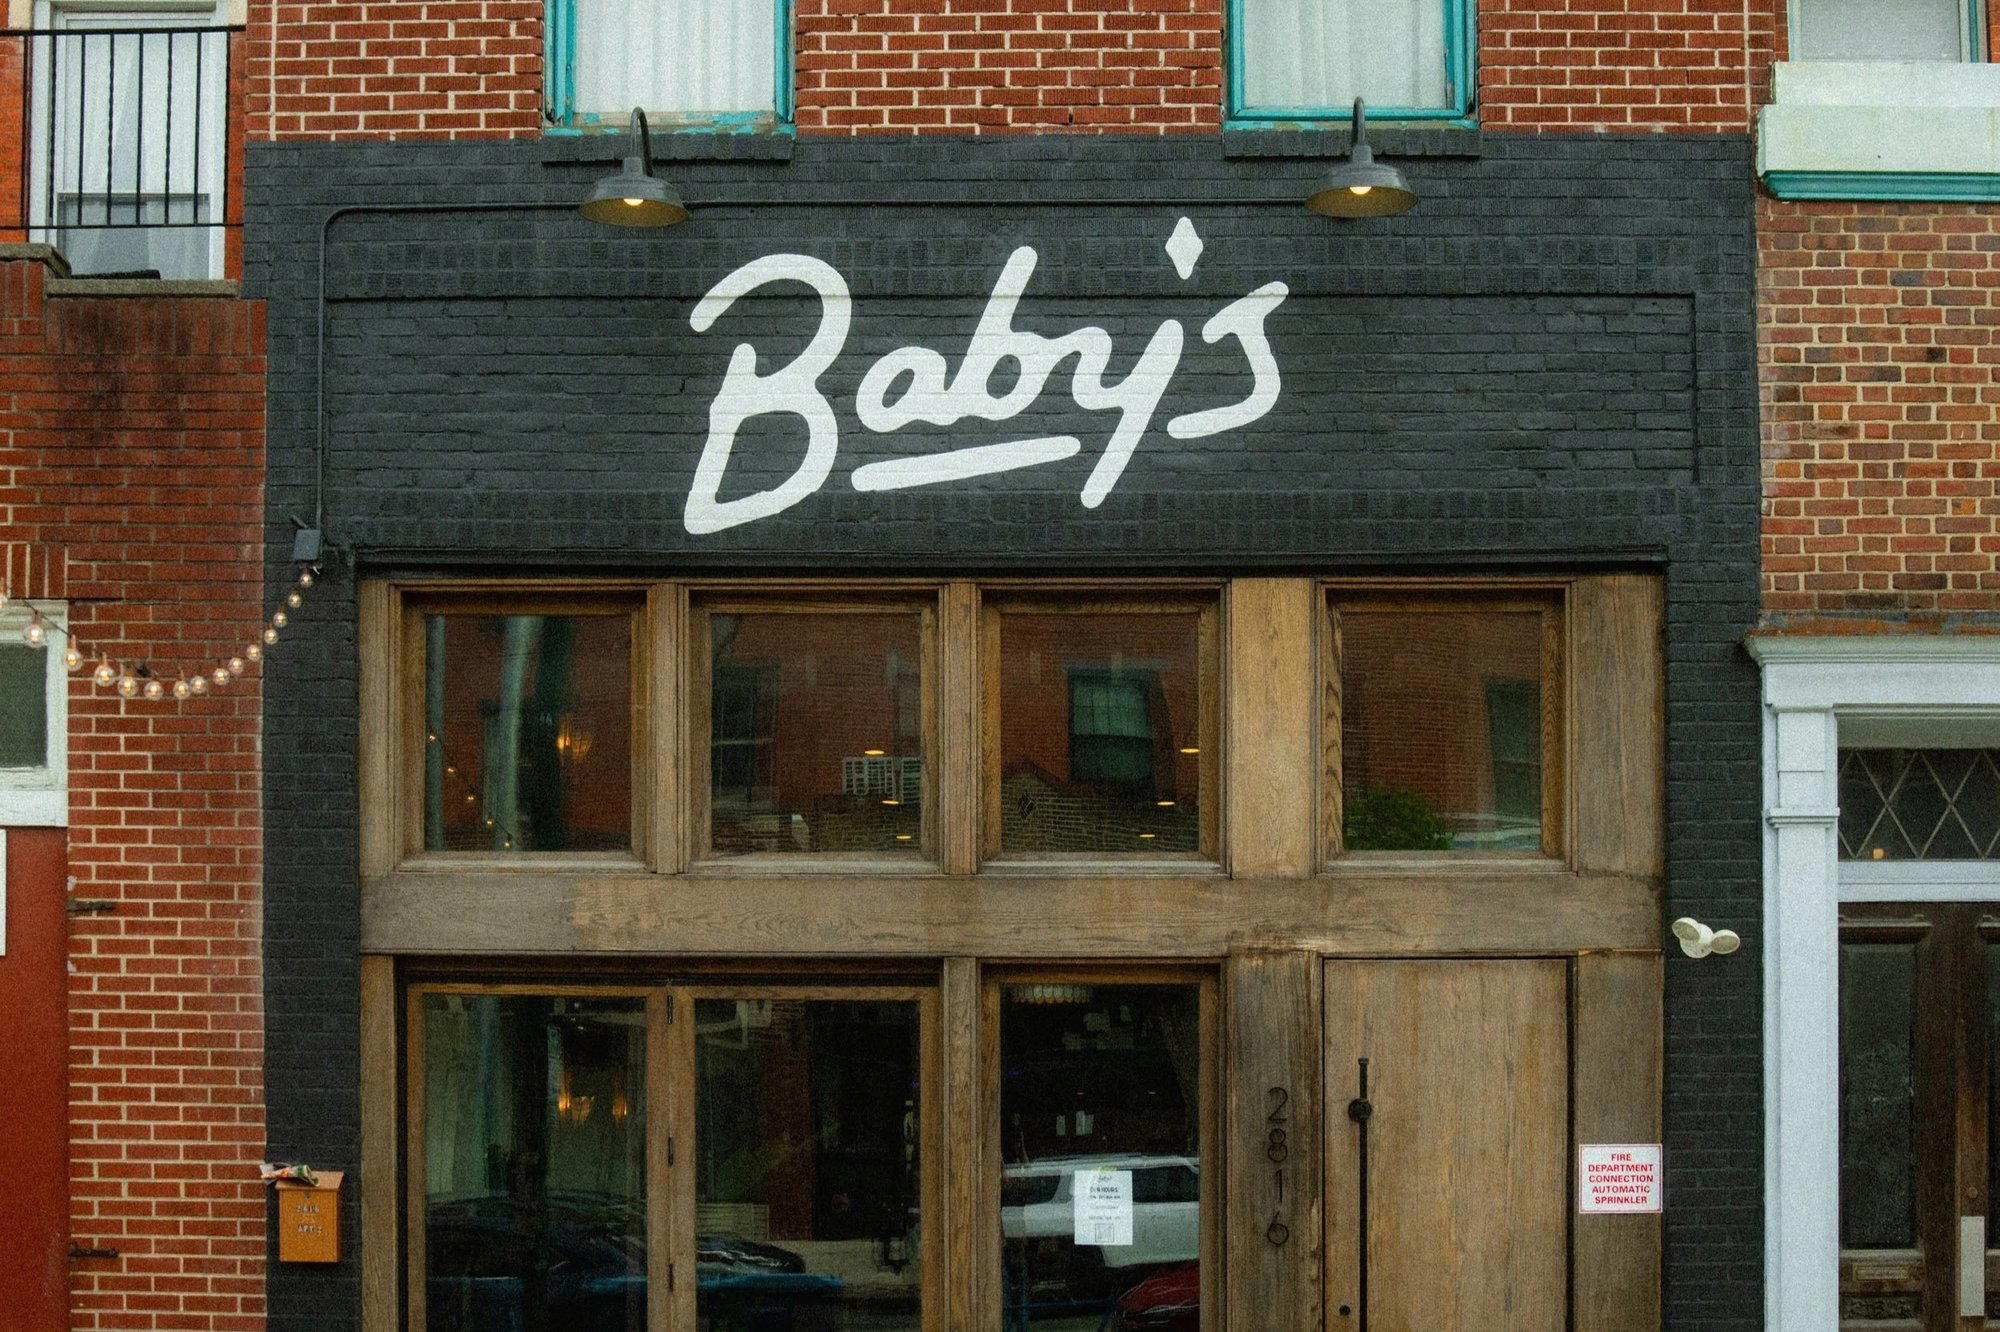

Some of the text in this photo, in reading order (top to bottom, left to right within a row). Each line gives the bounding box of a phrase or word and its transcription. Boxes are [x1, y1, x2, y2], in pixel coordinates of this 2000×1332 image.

[684, 216, 1290, 535] Baby's
[1611, 1153, 1632, 1162] FIRE
[1267, 1086, 1290, 1246] 2816
[1588, 1164, 1654, 1172] DEPARTMENT
[1588, 1175, 1654, 1183] CONNECTION
[1592, 1185, 1650, 1194] AUTOMATIC
[1595, 1196, 1647, 1204] SPRINKLER
